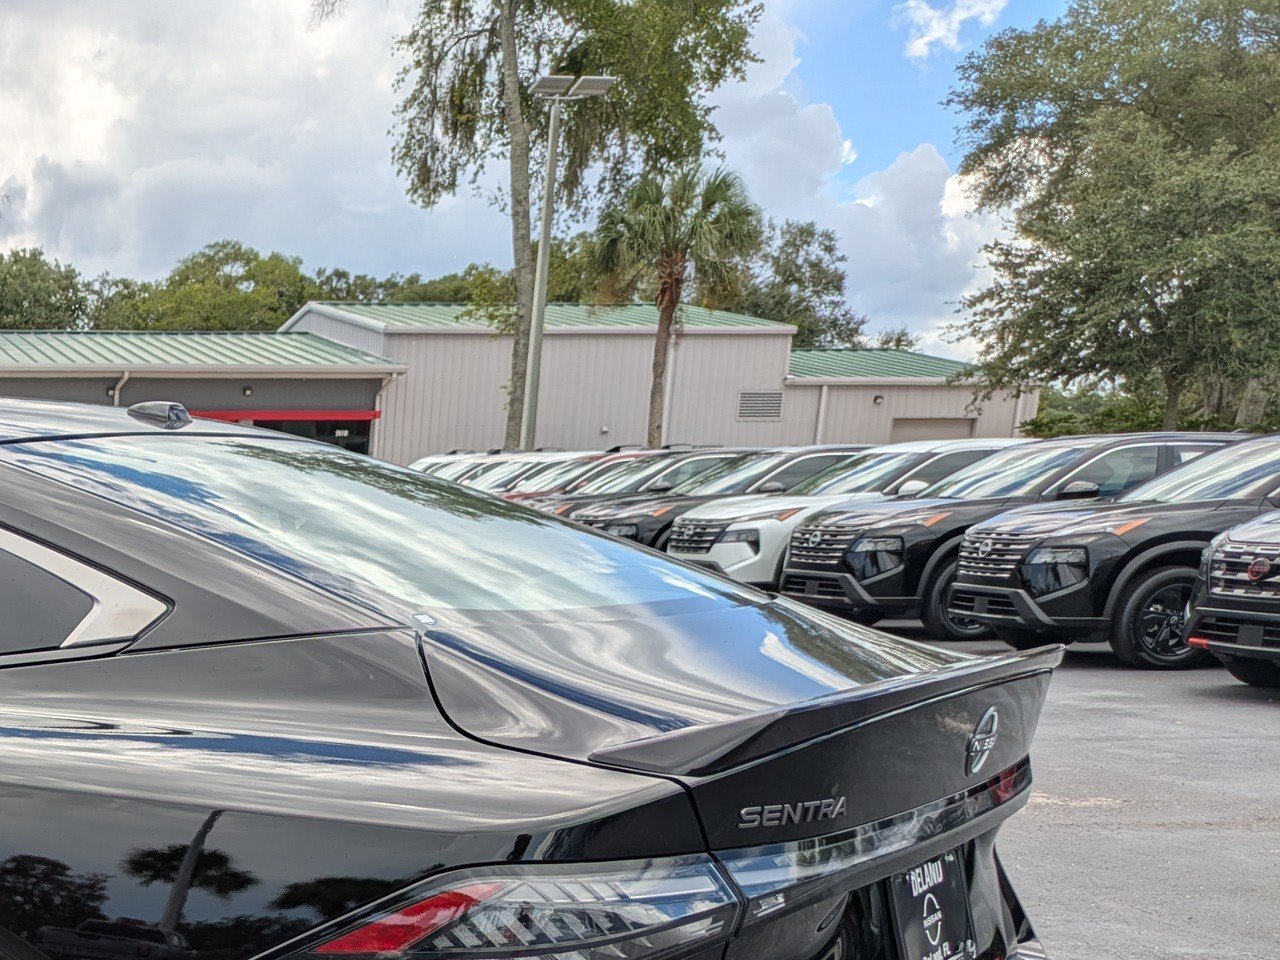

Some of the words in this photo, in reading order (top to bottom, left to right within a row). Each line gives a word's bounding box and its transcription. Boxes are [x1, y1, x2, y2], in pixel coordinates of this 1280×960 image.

[737, 797, 847, 829] SENTRA
[910, 860, 943, 897] DELAND
[923, 910, 942, 929] NISSAN
